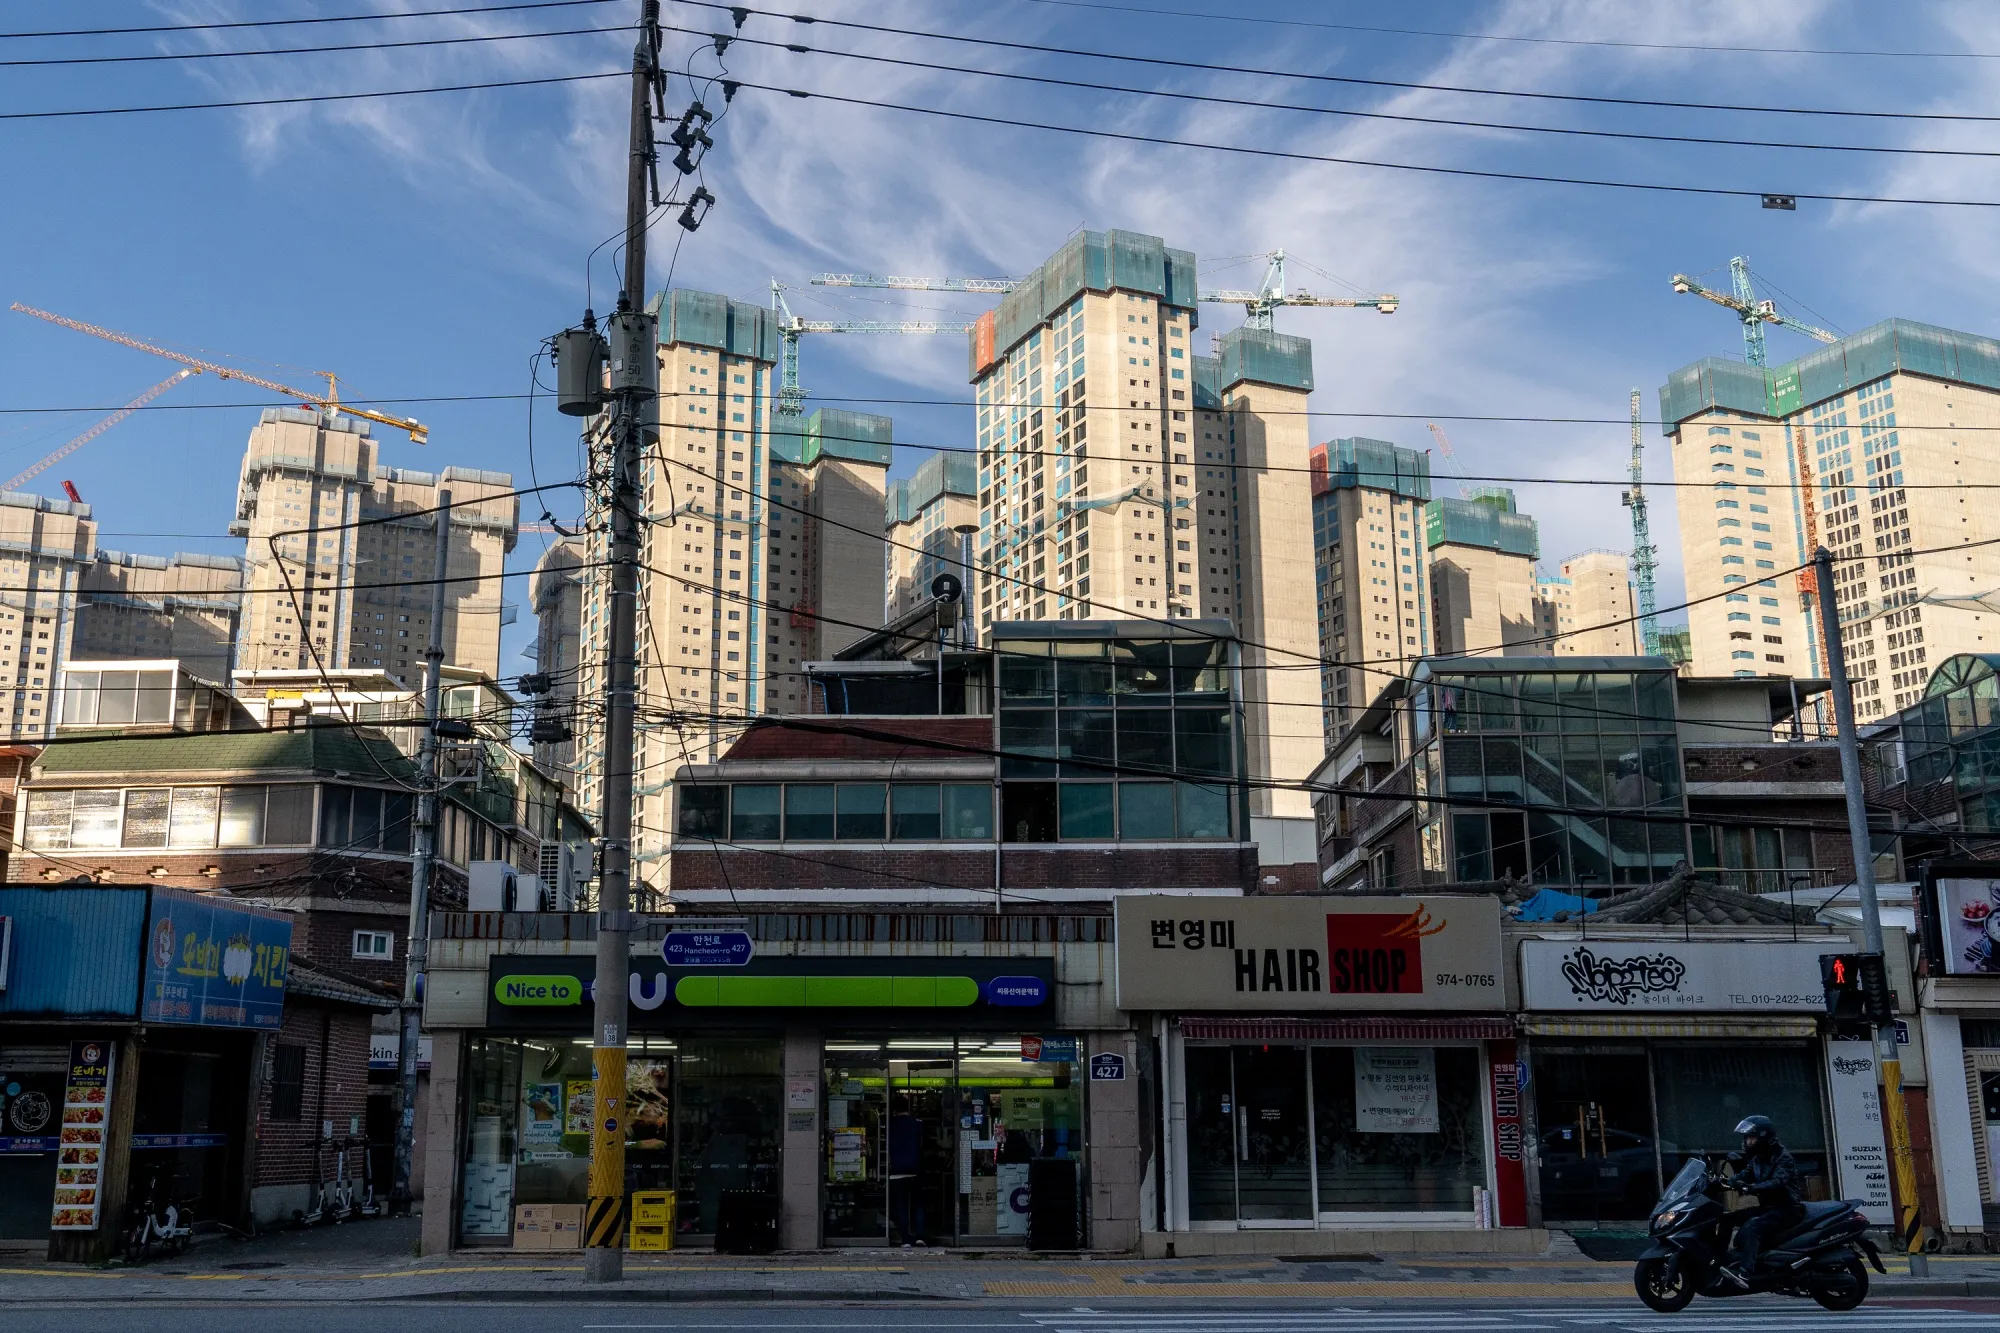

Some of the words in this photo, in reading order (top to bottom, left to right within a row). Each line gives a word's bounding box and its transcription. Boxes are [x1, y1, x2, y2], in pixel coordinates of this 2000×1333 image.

[628, 365, 640, 375] 50
[692, 934, 722, 946] 한천로
[1150, 919, 1235, 950] 변영미
[668, 944, 683, 953] 423
[684, 947, 731, 955] Hancheon-ro
[731, 944, 746, 952] 427
[252, 942, 288, 988] 치킨
[1235, 948, 1321, 992] HAIR
[1334, 947, 1407, 993] SHOP
[1436, 973, 1495, 987] 974-0765
[506, 983, 547, 999] Nice
[551, 984, 570, 999] to
[1641, 994, 1671, 1004] 놀이터
[1677, 994, 1705, 1004] 바이크
[607, 1034, 616, 1042] 38
[71, 1064, 107, 1077] 또바기
[1096, 1066, 1119, 1077] 427
[1494, 1063, 1515, 1072] 변영미
[1494, 1073, 1519, 1118] HAIR
[1862, 1091, 1877, 1101] 튜닝
[1864, 1102, 1879, 1110] 수리
[1865, 1112, 1880, 1121] 보험
[1497, 1123, 1523, 1162] SHOP
